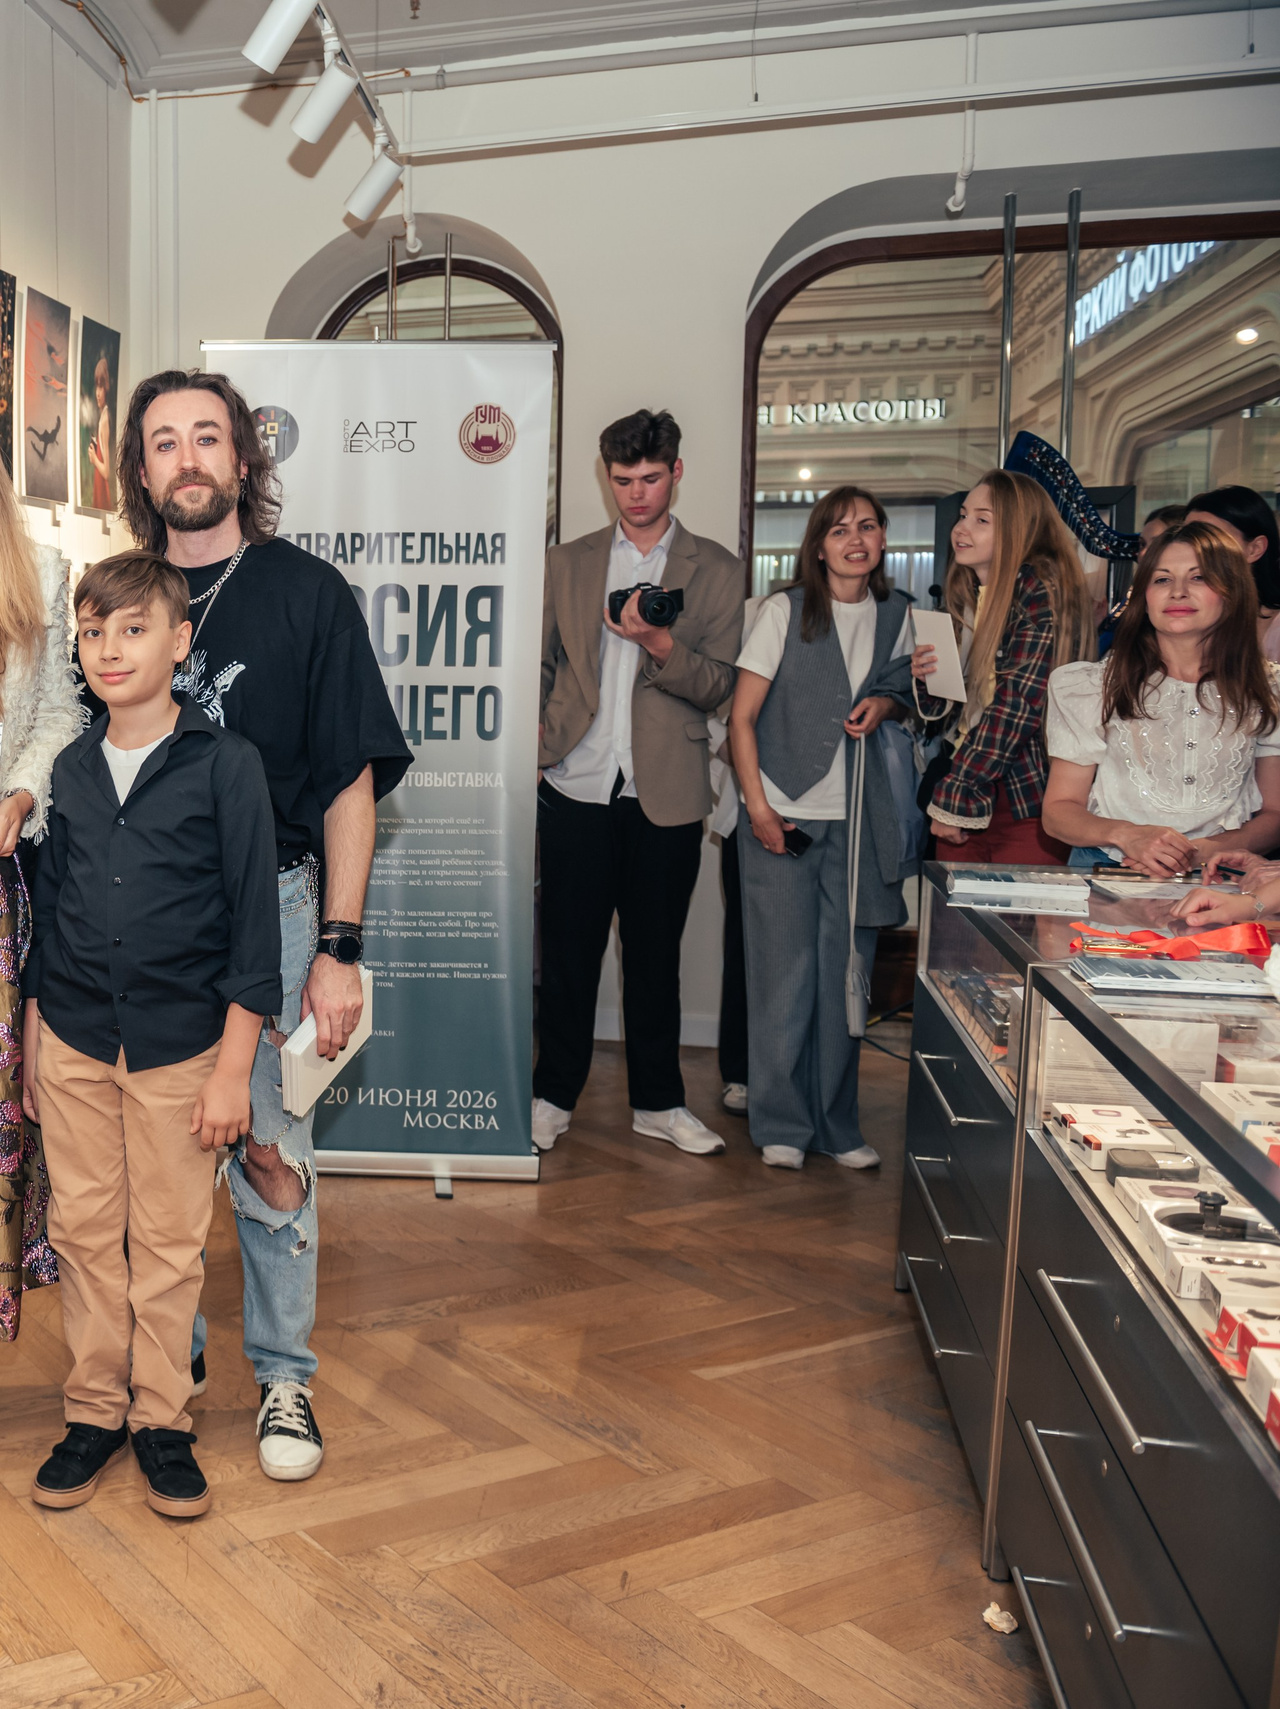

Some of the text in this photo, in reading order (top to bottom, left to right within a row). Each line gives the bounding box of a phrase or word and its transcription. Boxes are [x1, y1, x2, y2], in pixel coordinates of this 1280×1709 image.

[1129, 241, 1215, 303] ФОТО
[475, 404, 501, 424] ГУМ
[792, 398, 946, 424] КРАСОТЫ
[351, 421, 418, 439] ART
[349, 440, 415, 453] EXPO
[279, 532, 506, 565] ВАРИТЕЛЬНАЯ
[350, 583, 504, 667] СИЯ
[400, 828, 434, 836] смотрим
[424, 818, 455, 827] которой
[375, 848, 407, 856] которые
[373, 857, 399, 866] Между
[419, 858, 441, 866] какой
[442, 859, 472, 867] ребёнок
[373, 869, 420, 877] притворства
[323, 1086, 498, 1109] 20 ИЮНЯ 2026
[403, 1110, 500, 1130] МОСКВА
